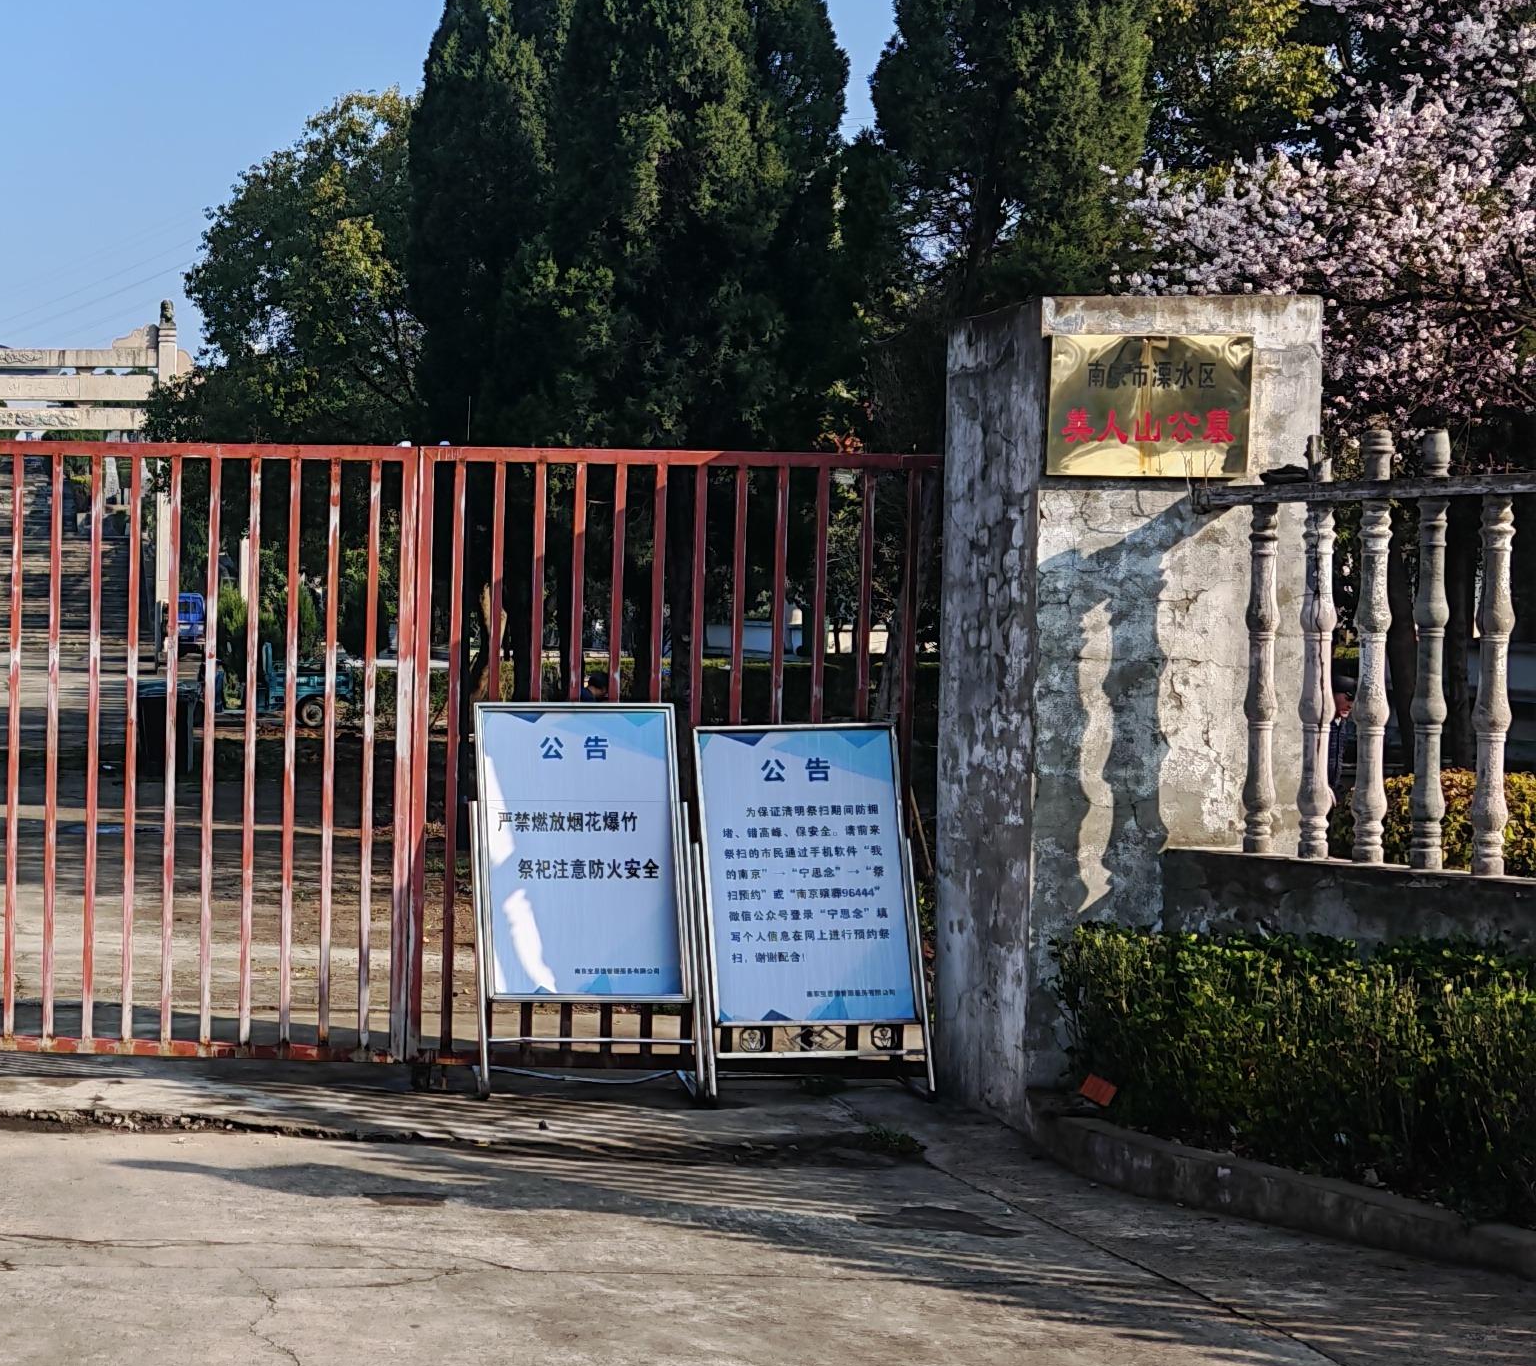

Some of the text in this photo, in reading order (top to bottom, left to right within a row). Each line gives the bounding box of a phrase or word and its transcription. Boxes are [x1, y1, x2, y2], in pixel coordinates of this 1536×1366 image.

[1061, 407, 1236, 445] 美人山公墓
[540, 736, 609, 761] 公告
[761, 757, 831, 782] 公告
[497, 811, 638, 833] 严禁燃放烟花爆竹
[745, 804, 880, 818] 为保证清明祭扫期间防拥
[518, 858, 660, 880] 祭祀注意防火安全
[730, 928, 891, 943] 写个人信息在网上进行预约祭
